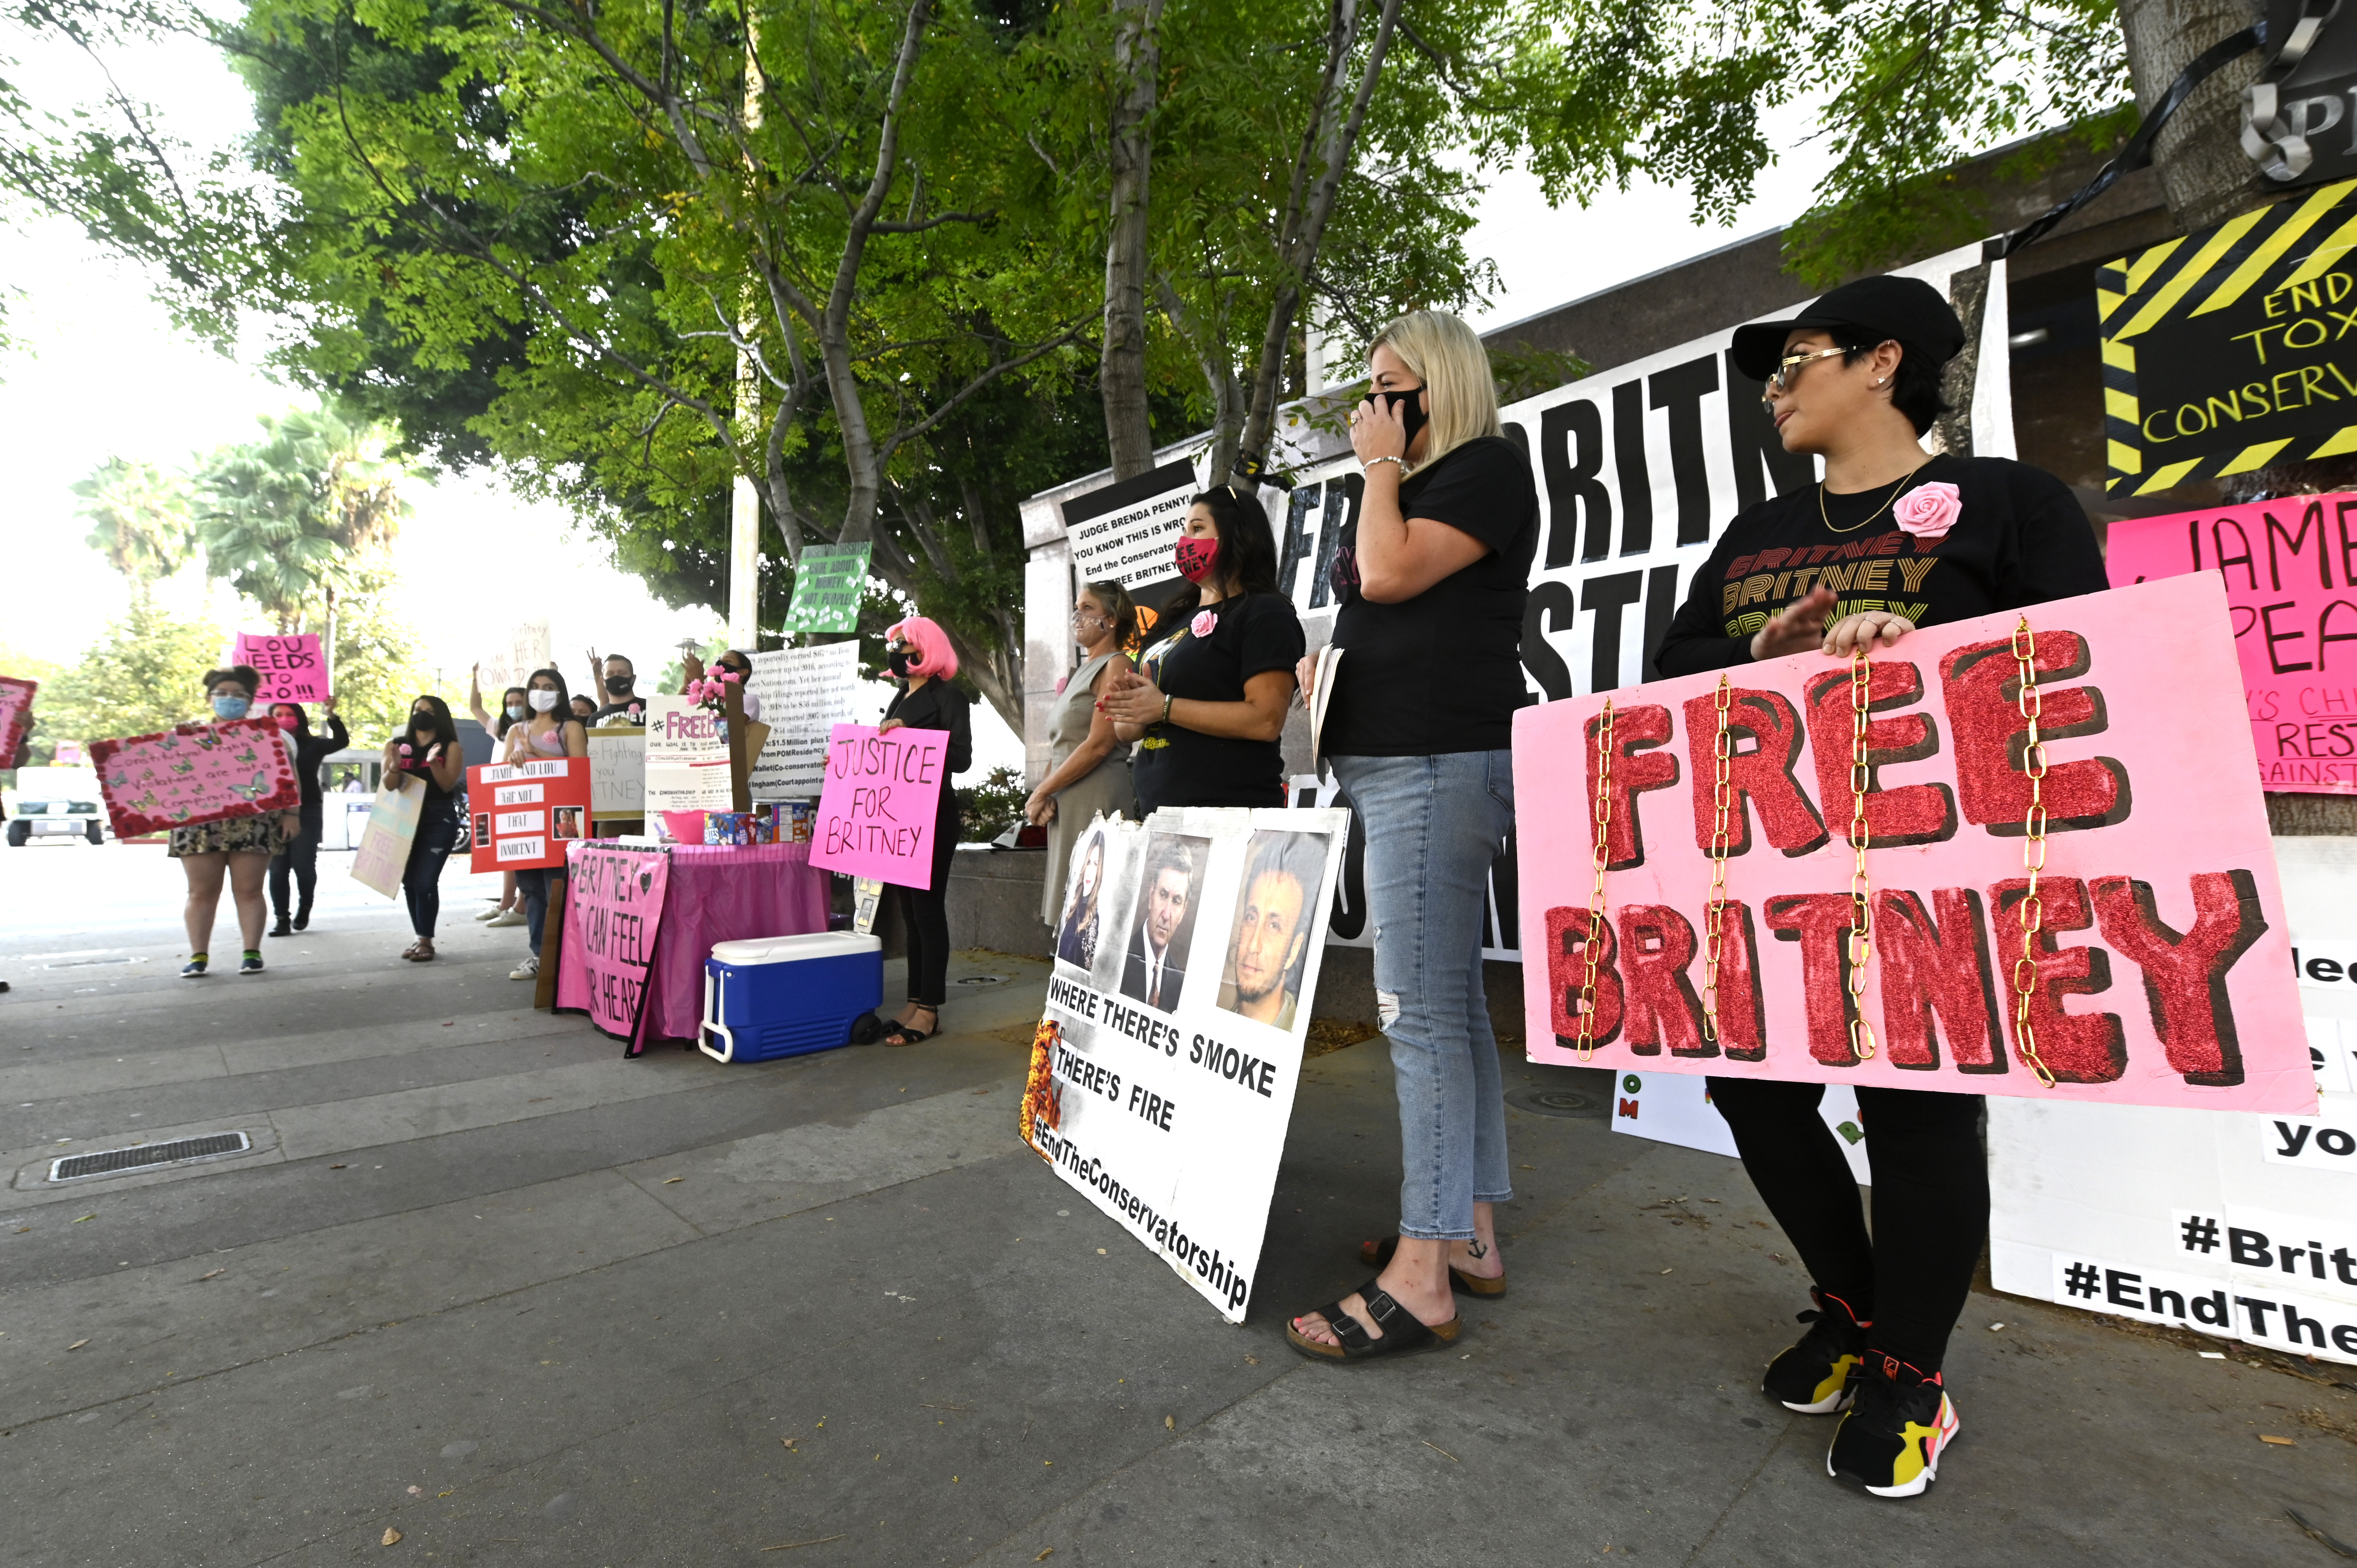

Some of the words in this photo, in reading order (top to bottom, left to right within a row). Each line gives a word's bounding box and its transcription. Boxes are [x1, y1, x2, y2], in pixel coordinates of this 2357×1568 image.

[2264, 272, 2353, 318] END
[1079, 523, 1109, 540] JUDGE
[1111, 509, 1150, 529] BRENDA
[1152, 494, 1190, 515] PENNY!
[1074, 547, 1093, 560] YOU
[1096, 537, 1124, 554] KNOW
[1126, 529, 1149, 544] THIS
[1151, 525, 1161, 535] IS
[830, 559, 856, 573] ABOUT
[1086, 564, 1102, 576] End
[1104, 559, 1118, 570] the
[1724, 531, 1950, 580] BRITNEY
[815, 576, 845, 589] MONEY!
[1113, 573, 1133, 585] REE
[1135, 561, 1177, 581] BRITNEY
[1723, 557, 1938, 616] BRITNEY
[803, 593, 818, 604] NOT
[822, 593, 853, 605] PEOPLE!
[244, 635, 302, 652] LOU
[514, 639, 544, 663] HER
[791, 651, 811, 660] earned
[237, 652, 315, 669] NEEDS
[262, 673, 292, 684] TO
[481, 666, 511, 686] OWN
[773, 690, 793, 698] filings
[794, 687, 818, 697] reported
[651, 710, 718, 740] #FREEB
[781, 713, 804, 722] reported
[601, 739, 642, 766] Fighting
[835, 738, 936, 784] JUSTICE
[1583, 630, 2133, 870] FREE
[205, 770, 230, 779] are
[236, 763, 256, 773] not
[491, 768, 513, 780] JAMIE
[521, 763, 535, 776] AND
[539, 762, 557, 774] LOU
[595, 768, 615, 779] you
[501, 792, 515, 803] ARE
[518, 789, 532, 802] NOT
[852, 787, 897, 822] FOR
[508, 814, 527, 828] THAT
[705, 828, 719, 842] BITES
[826, 816, 921, 857] BRITNEY
[501, 841, 537, 856] INNOCENT
[578, 855, 640, 902] BRITNEY
[586, 905, 608, 956] CAN
[611, 911, 648, 967] FEEL
[1545, 869, 2268, 1087] BRITNEY
[1050, 976, 1099, 1019] WHERE
[1103, 998, 1178, 1058] THERE'S
[1189, 1034, 1276, 1098] SMOKE
[1057, 1045, 1121, 1102] THERE'S
[1128, 1084, 1176, 1133] FIRE
[1034, 1115, 1248, 1311] #EndTheConservatorship
